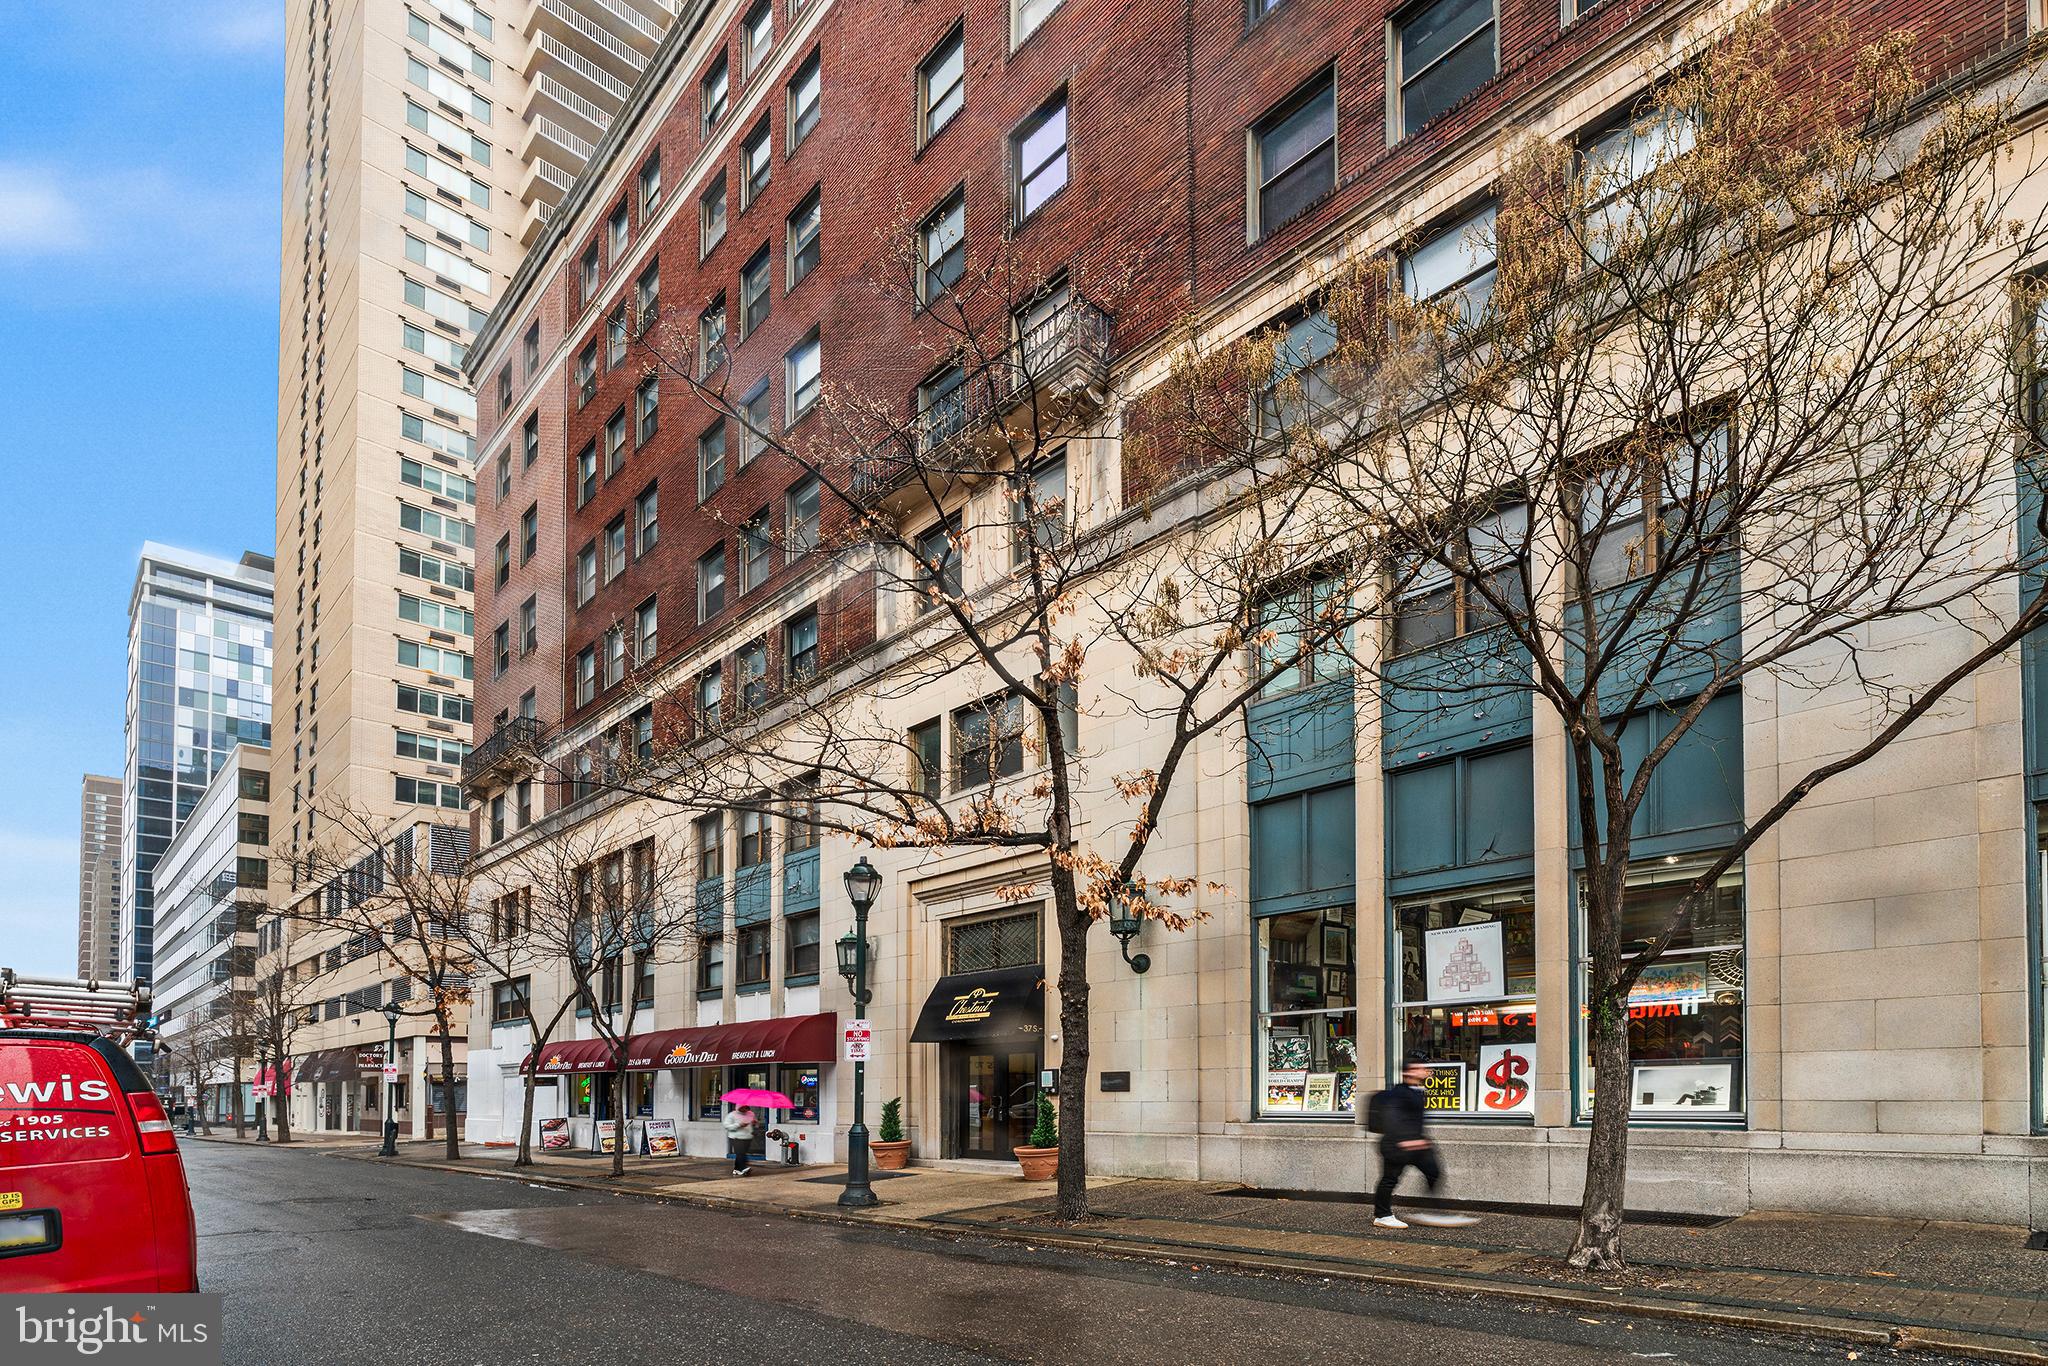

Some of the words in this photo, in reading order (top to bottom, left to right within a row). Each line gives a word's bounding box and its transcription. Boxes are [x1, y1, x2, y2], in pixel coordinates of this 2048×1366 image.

[949, 1000, 994, 1017] Chestnut
[731, 1050, 755, 1060] BREAKFAST
[760, 1050, 776, 1058] LUNCH
[1435, 1068, 1458, 1076] THINGS
[1424, 1077, 1456, 1088] OME
[0, 1074, 110, 1104] wis
[1424, 1097, 1460, 1109] USTLE
[16, 1114, 64, 1126] 1905
[0, 1126, 110, 1143] SERVICES
